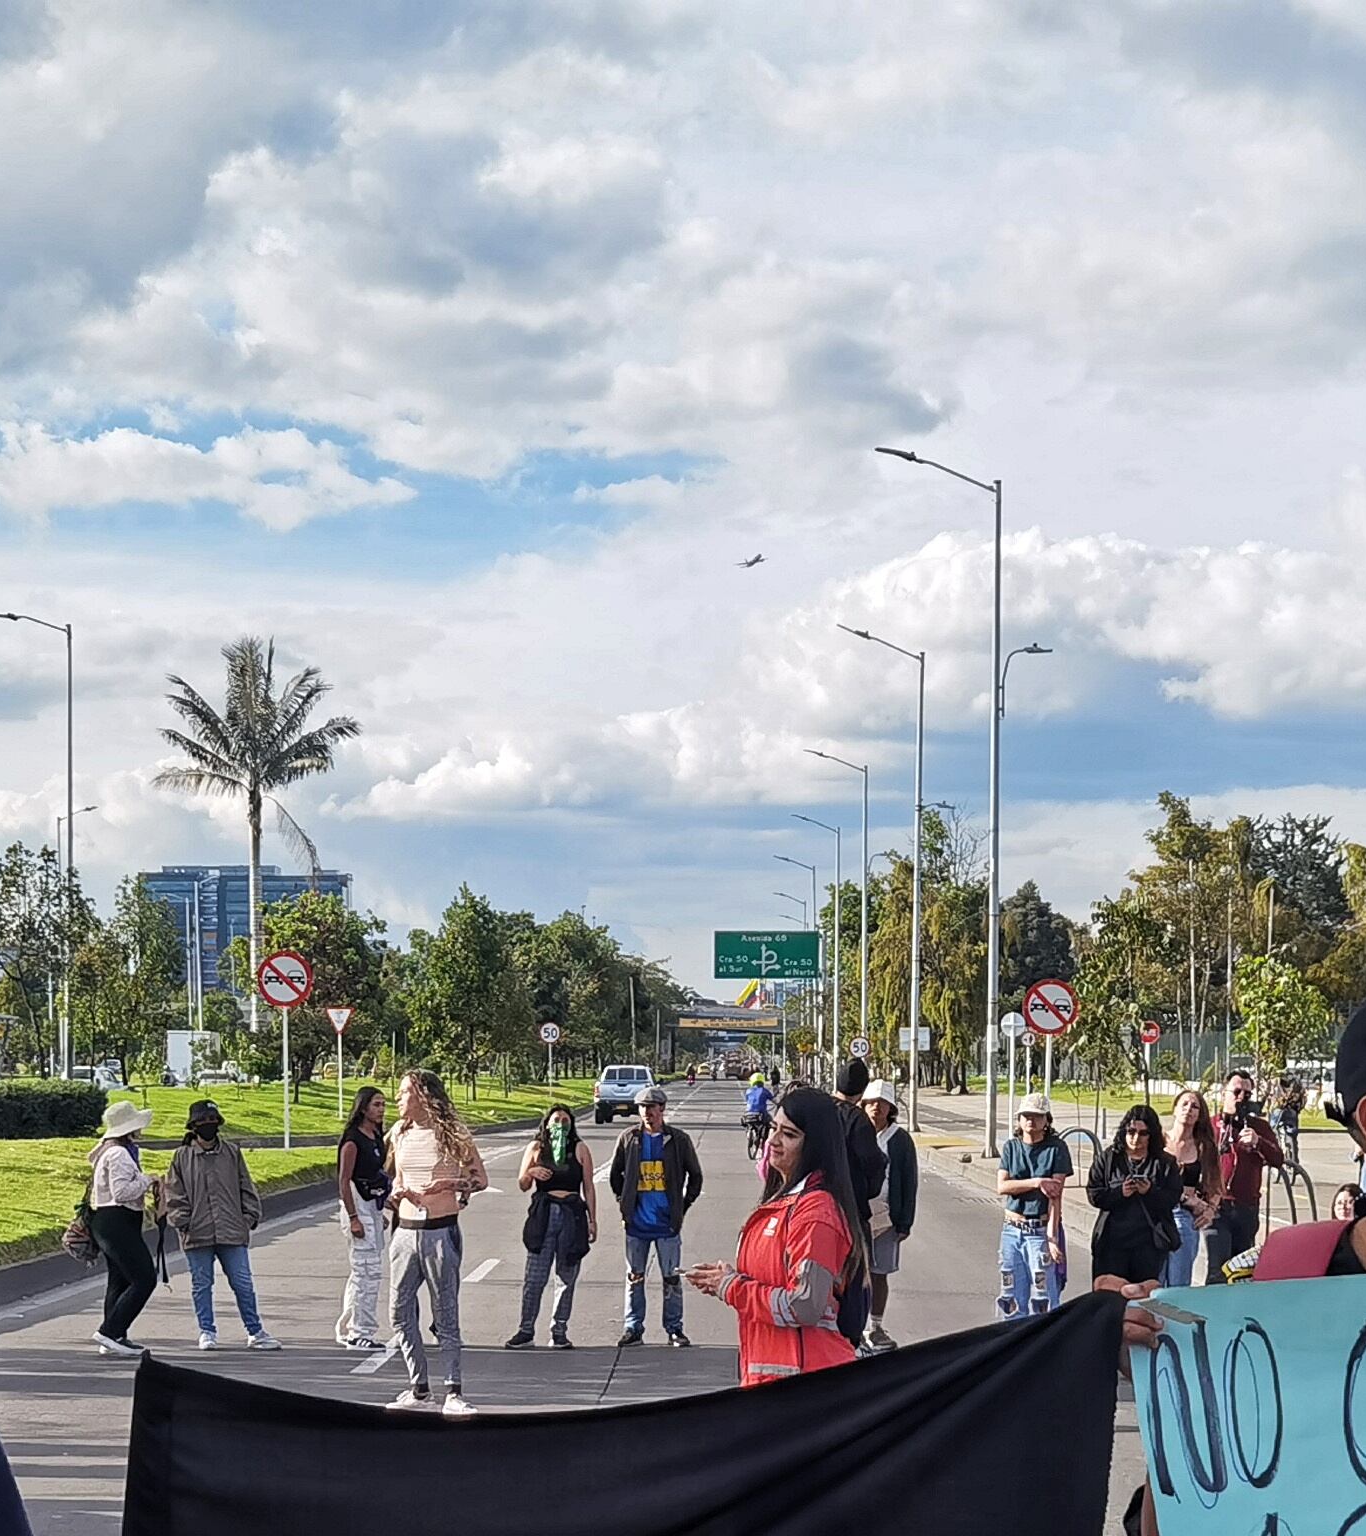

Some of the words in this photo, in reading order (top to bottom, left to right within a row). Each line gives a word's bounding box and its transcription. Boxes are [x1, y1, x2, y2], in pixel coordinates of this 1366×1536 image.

[718, 955, 733, 963] Cra
[736, 955, 749, 963] 50
[783, 958, 798, 966] Cra
[800, 958, 813, 966] 50
[718, 965, 727, 973] al
[729, 965, 744, 973] Sur
[784, 968, 792, 976] al
[792, 968, 815, 976] Norte
[543, 1027, 558, 1039] 50
[853, 1041, 868, 1054] 50
[1147, 1316, 1283, 1503] NO
